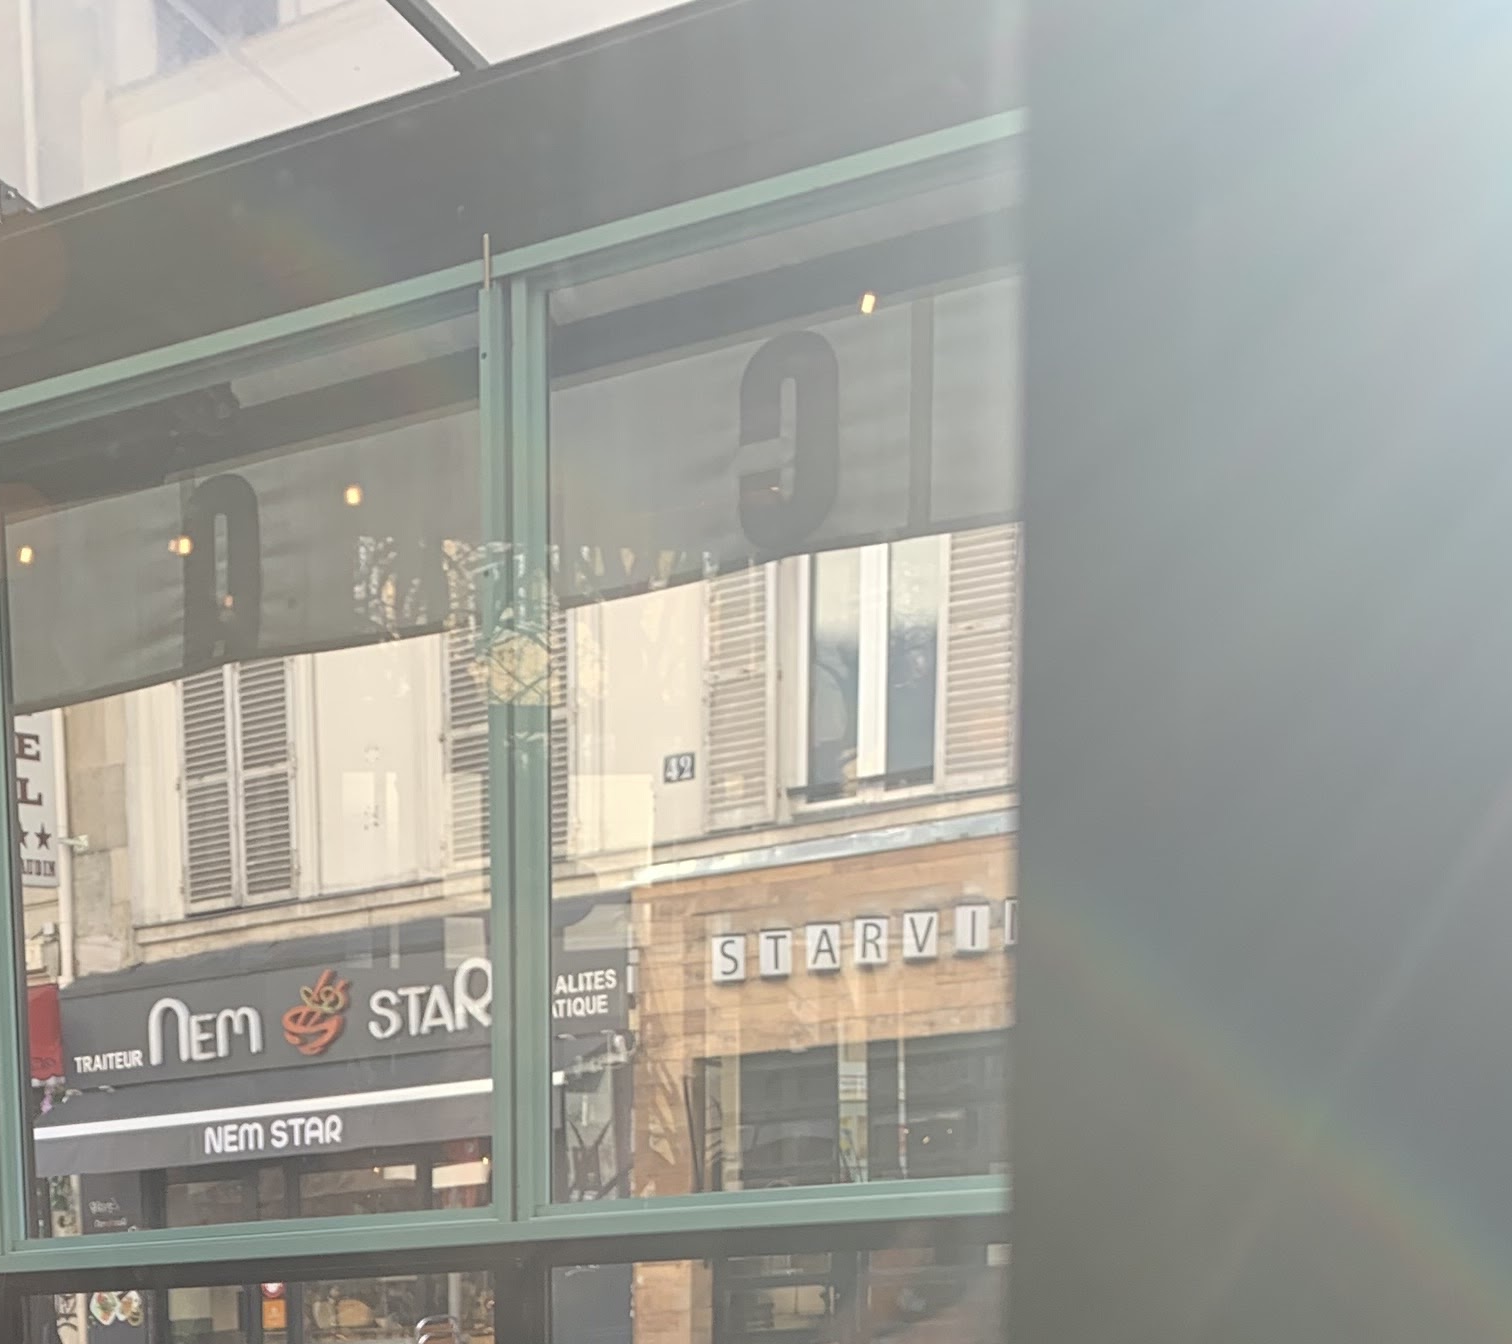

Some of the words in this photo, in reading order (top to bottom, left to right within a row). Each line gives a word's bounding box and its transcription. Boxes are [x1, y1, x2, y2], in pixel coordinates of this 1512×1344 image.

[16, 713, 42, 806] EL
[666, 756, 692, 780] 42
[74, 1050, 143, 1073] TRAITEUR
[368, 957, 493, 1039] STAR
[204, 1121, 265, 1155] NEM
[270, 1114, 343, 1148] STAR
